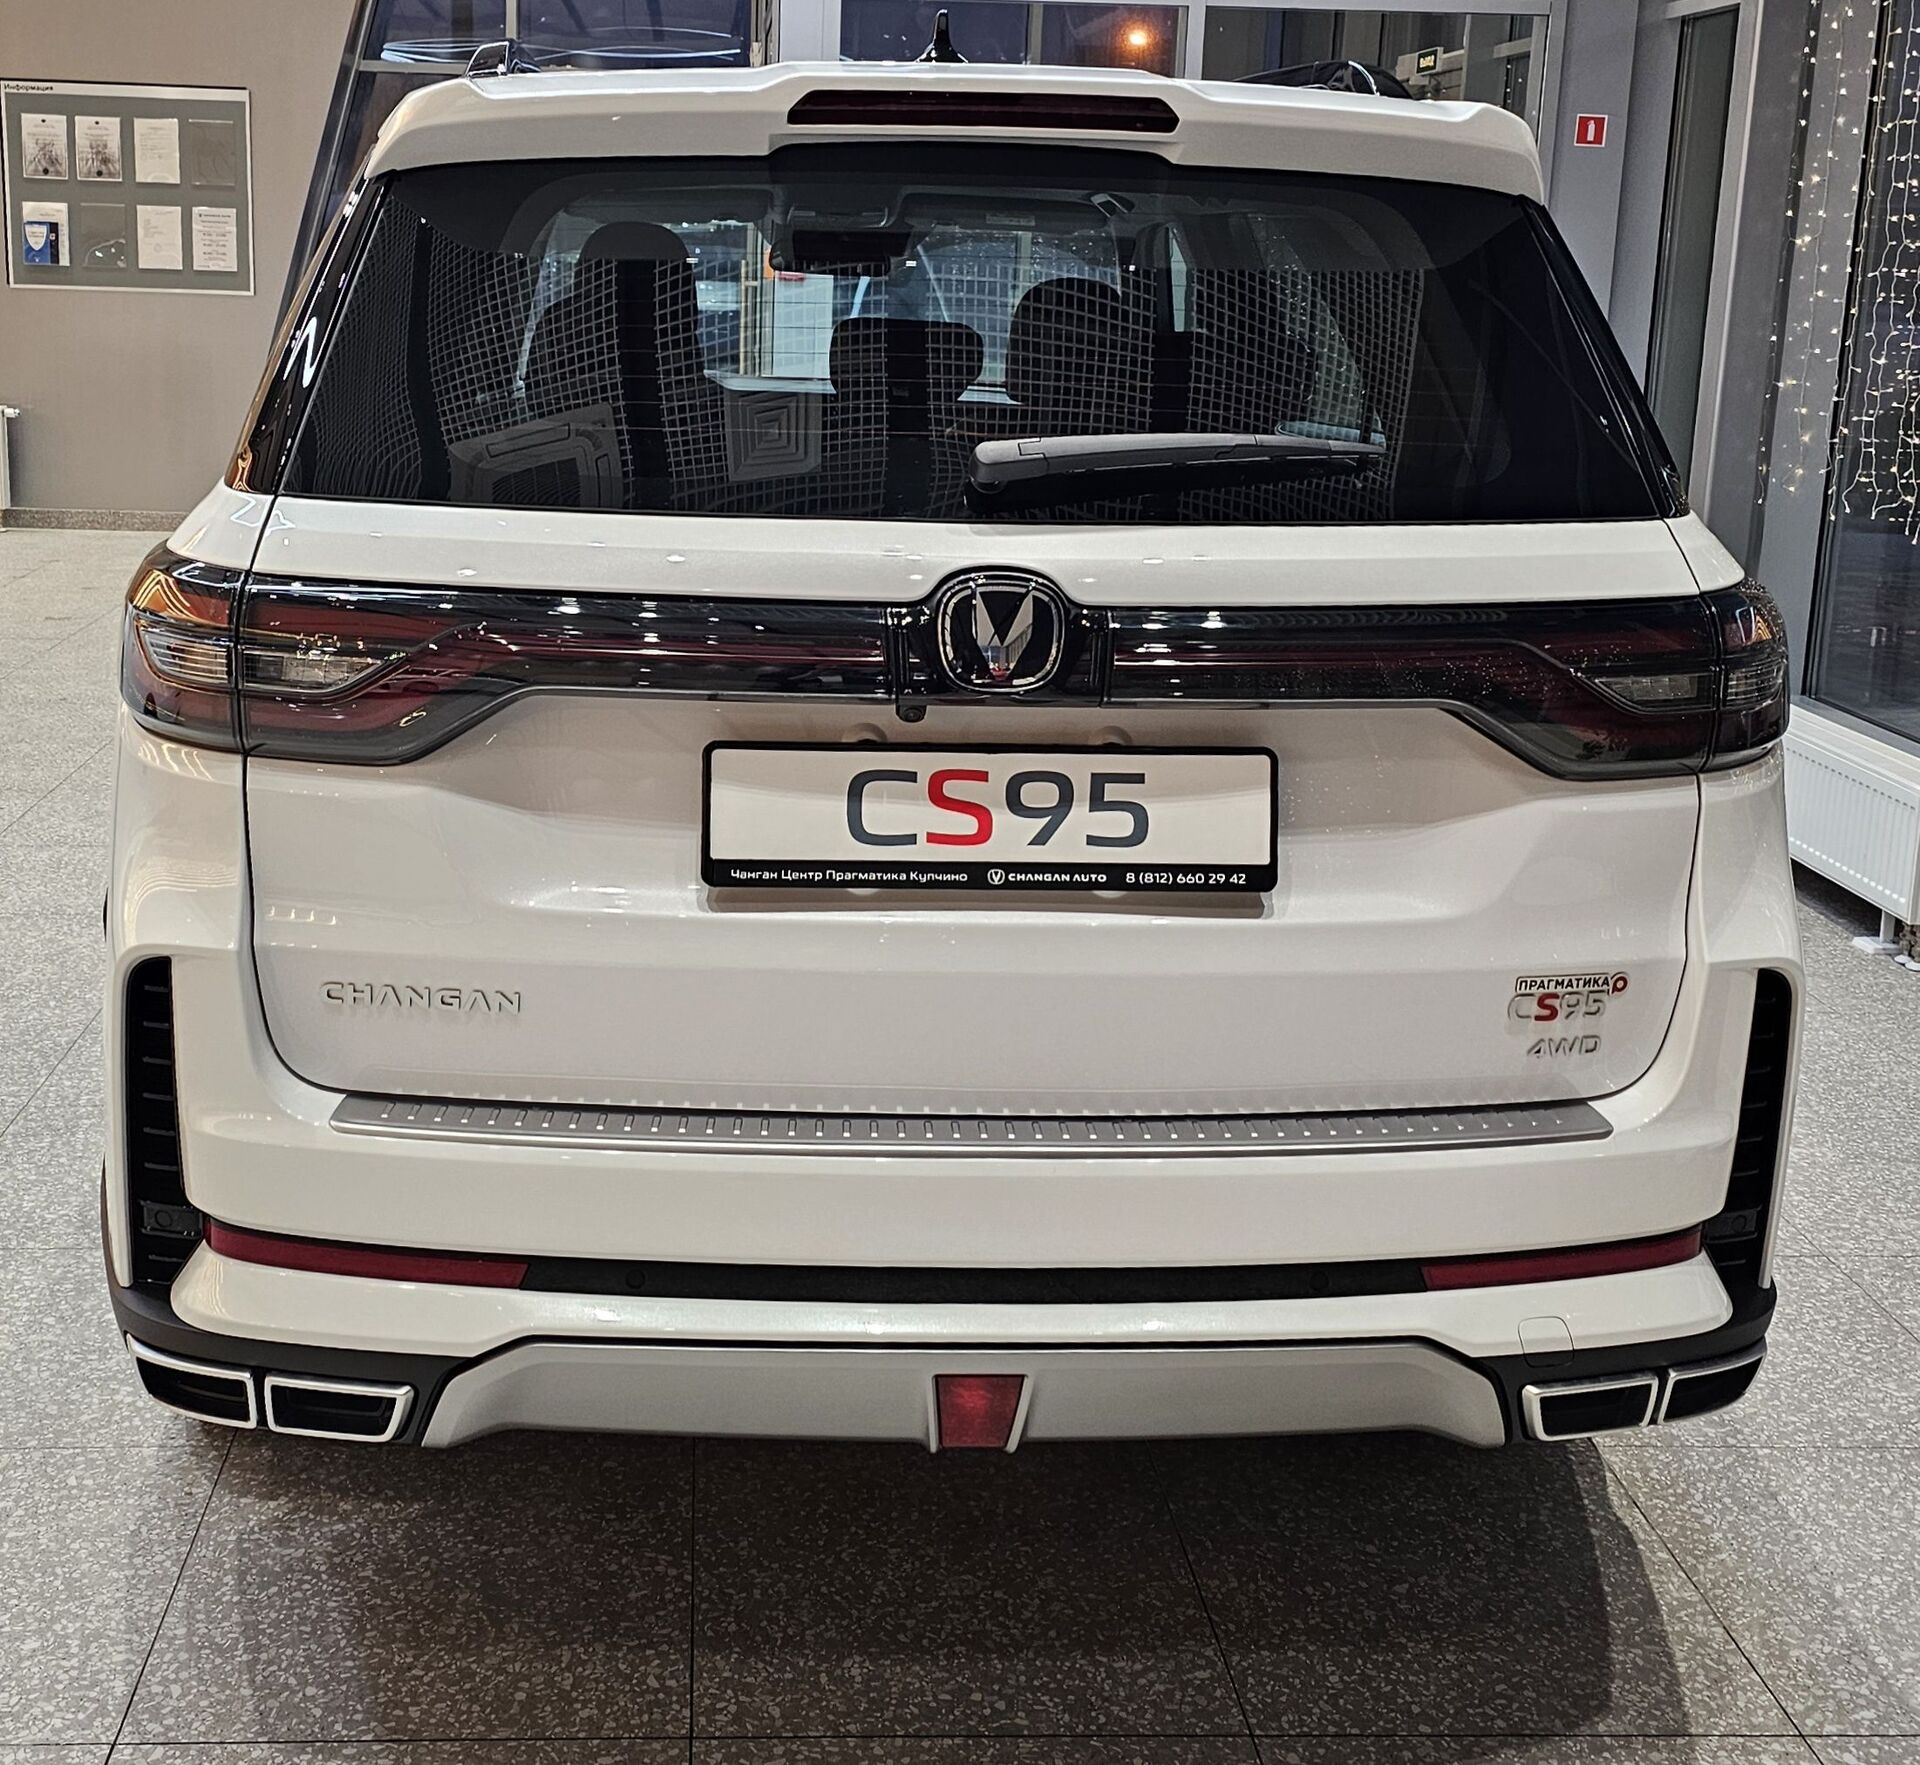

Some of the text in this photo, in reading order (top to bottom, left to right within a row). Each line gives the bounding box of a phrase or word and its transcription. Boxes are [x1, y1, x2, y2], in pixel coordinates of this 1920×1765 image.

[846, 769, 1149, 847] CS95
[731, 868, 968, 883] Чанган Центр Прагматика Купчино
[1008, 872, 1107, 883] CHANGAN AUTO
[1125, 872, 1247, 885] 8 (812) 660 29 42
[1518, 976, 1610, 991] ПРАГМАТИКА
[319, 981, 522, 1015] CHANGAN
[1507, 990, 1606, 1021] CS95
[1527, 1035, 1601, 1058] 4WD
